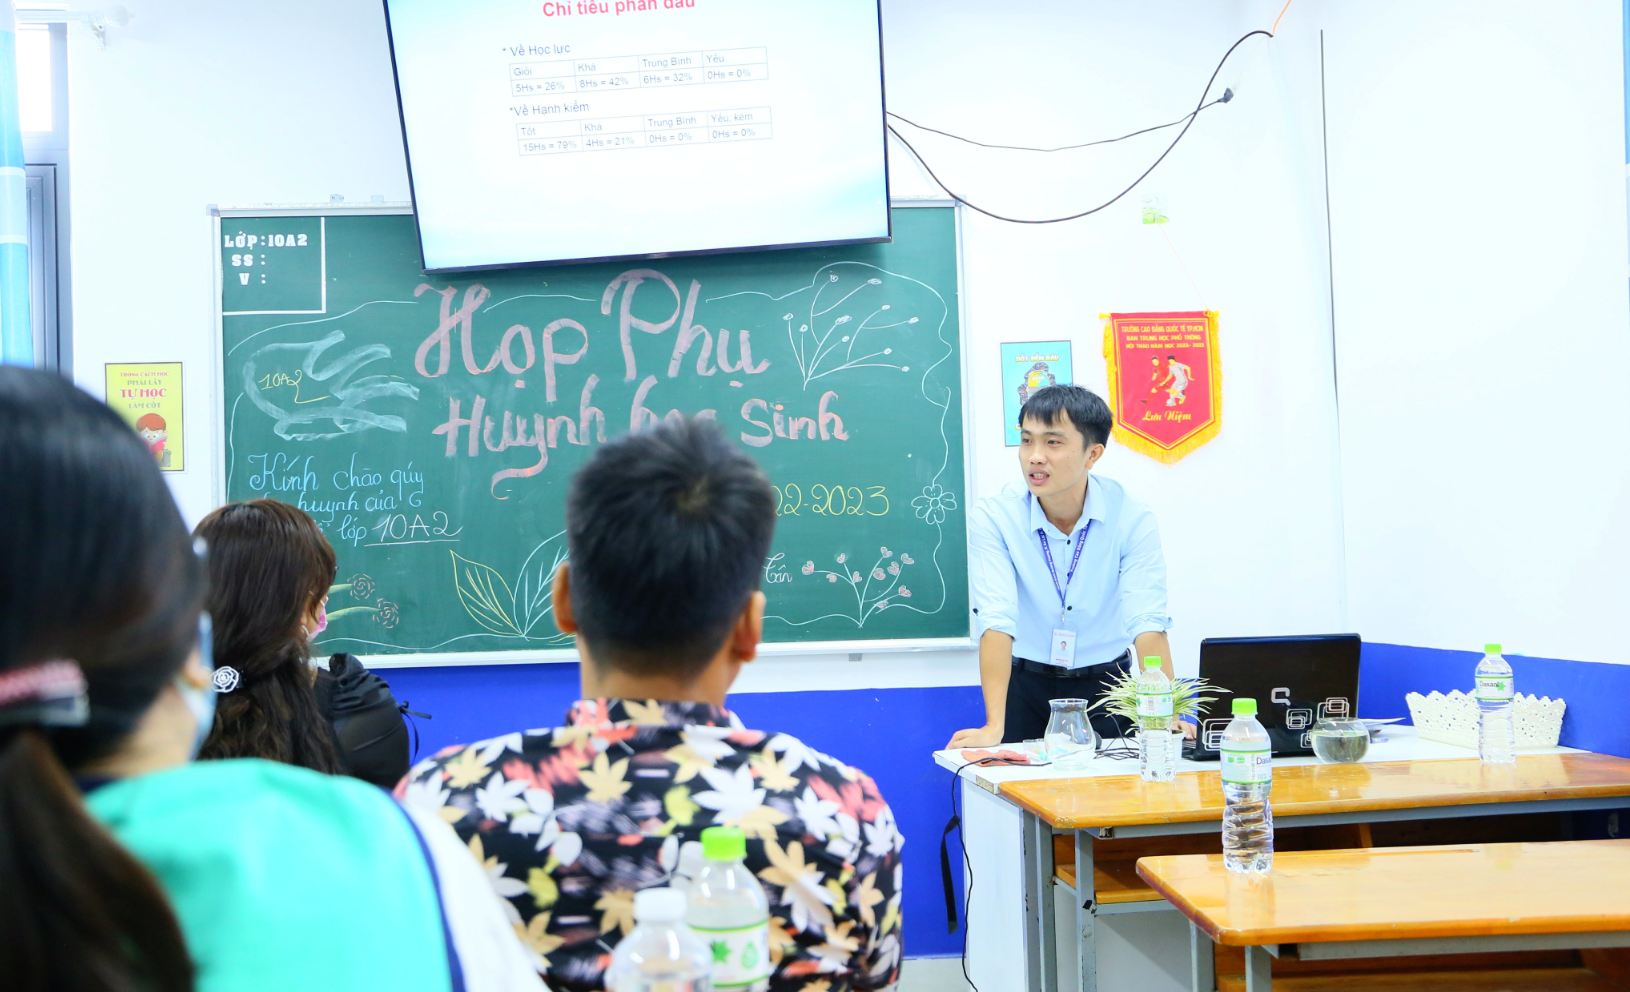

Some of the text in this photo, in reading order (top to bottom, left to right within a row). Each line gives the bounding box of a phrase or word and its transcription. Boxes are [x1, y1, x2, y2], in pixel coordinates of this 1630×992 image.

[510, 44, 571, 57] Về Học lực
[642, 58, 669, 69] Trung
[515, 82, 534, 93] 5Hs
[544, 81, 565, 91] 26%
[579, 79, 598, 89] 8Hs
[608, 76, 629, 86] 42%
[643, 74, 662, 84] 6Hs
[672, 72, 693, 82] 32%
[736, 68, 751, 78] 0%
[532, 104, 561, 117] Hạnh
[563, 100, 590, 113] kiểm
[647, 118, 674, 128] Trung
[523, 142, 547, 152] 15Hs
[557, 140, 577, 149] 79%
[585, 138, 604, 148] 4Hs
[614, 136, 635, 146] 21%
[677, 132, 693, 142] 0%
[740, 128, 756, 137] 0%
[414, 268, 772, 402] Họp Phụ
[120, 387, 168, 400] TỰ HỌC
[1142, 410, 1162, 421] Lưu
[431, 374, 608, 500] Huynh
[741, 390, 849, 447] Sinh
[248, 452, 320, 492] Kính
[365, 489, 398, 512] của
[771, 482, 889, 517] 22-2023
[336, 514, 367, 547] lớp
[371, 511, 464, 542] 10A2
